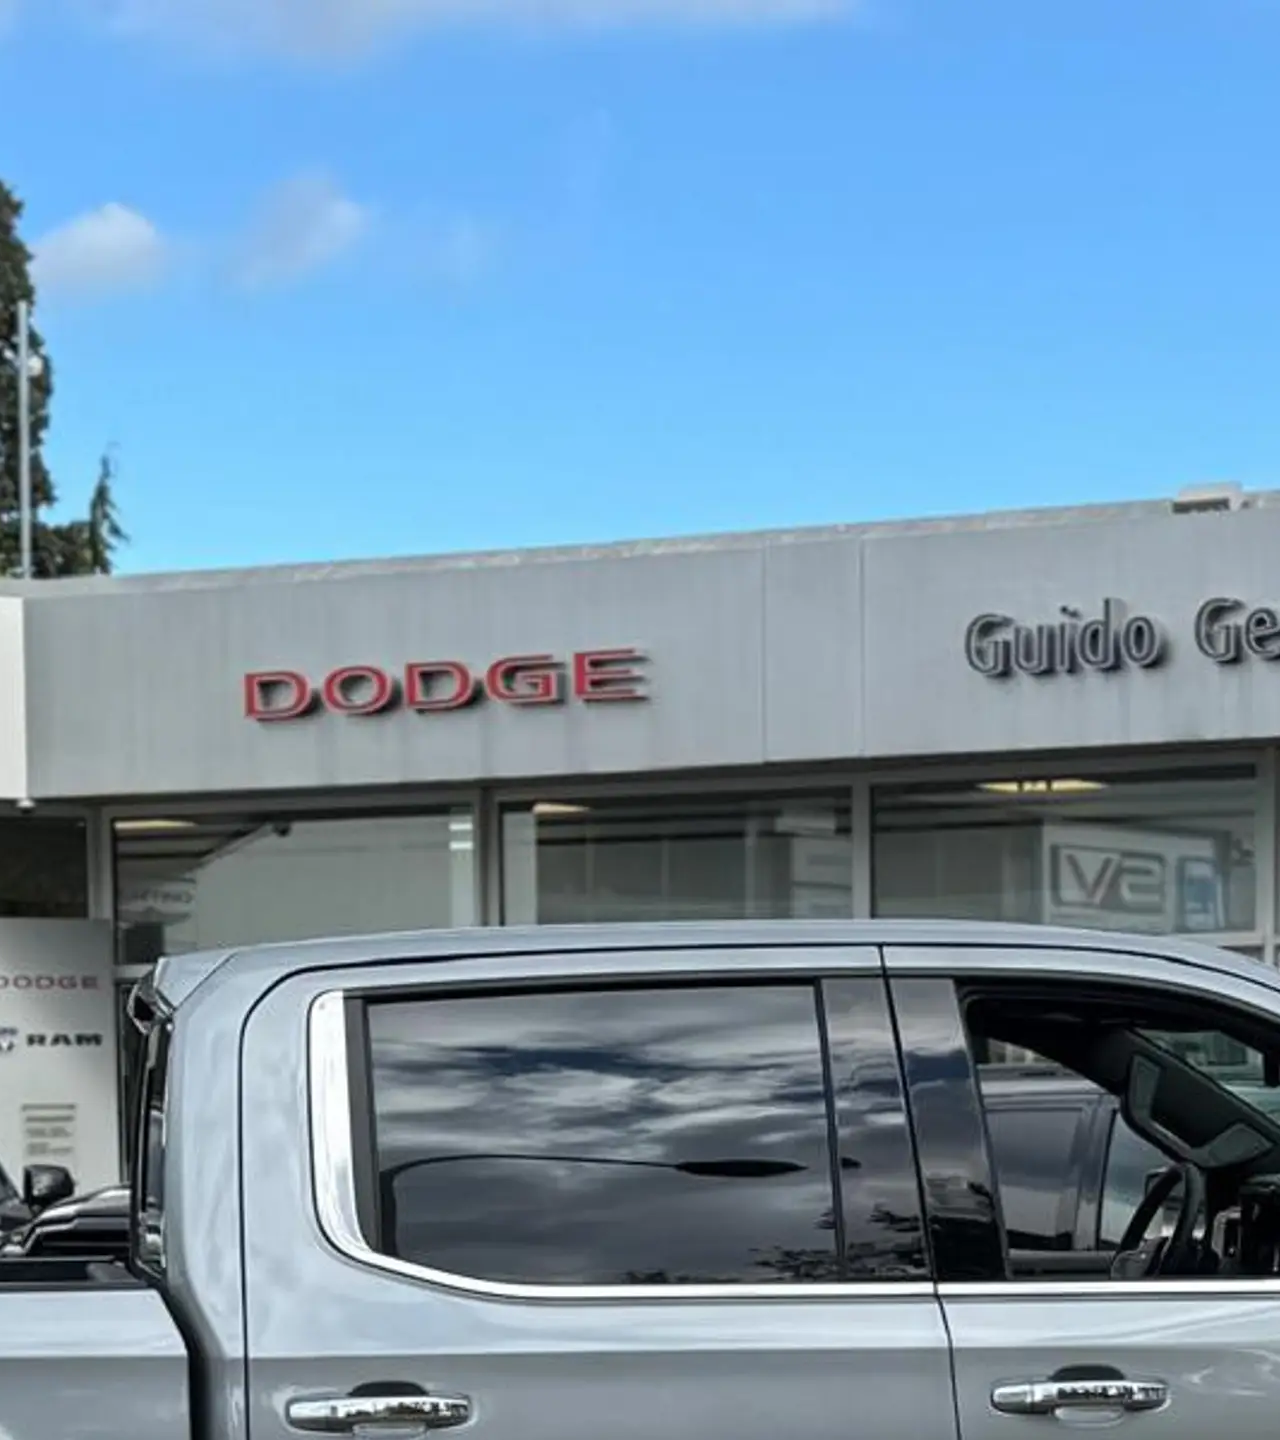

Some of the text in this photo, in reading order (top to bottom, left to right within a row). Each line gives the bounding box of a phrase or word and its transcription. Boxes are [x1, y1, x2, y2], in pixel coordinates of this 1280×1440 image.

[964, 598, 1164, 680] Guido
[242, 647, 648, 721] DODGE
[26, 1032, 104, 1047] RAM
